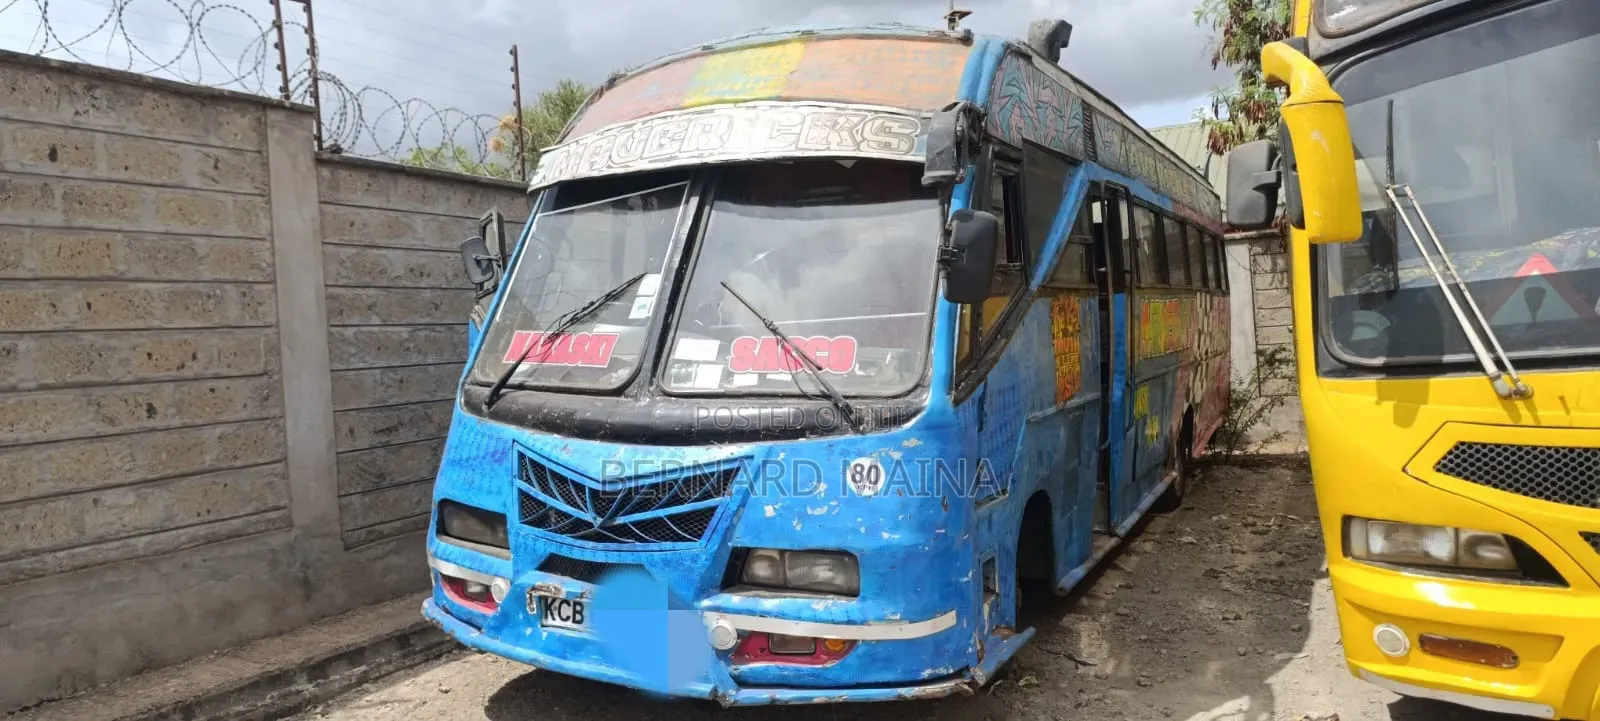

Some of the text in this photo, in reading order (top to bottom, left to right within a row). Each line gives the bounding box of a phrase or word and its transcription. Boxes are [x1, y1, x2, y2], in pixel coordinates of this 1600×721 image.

[730, 336, 857, 374] SACCO
[851, 463, 881, 486] 80
[543, 597, 585, 625] KCB
